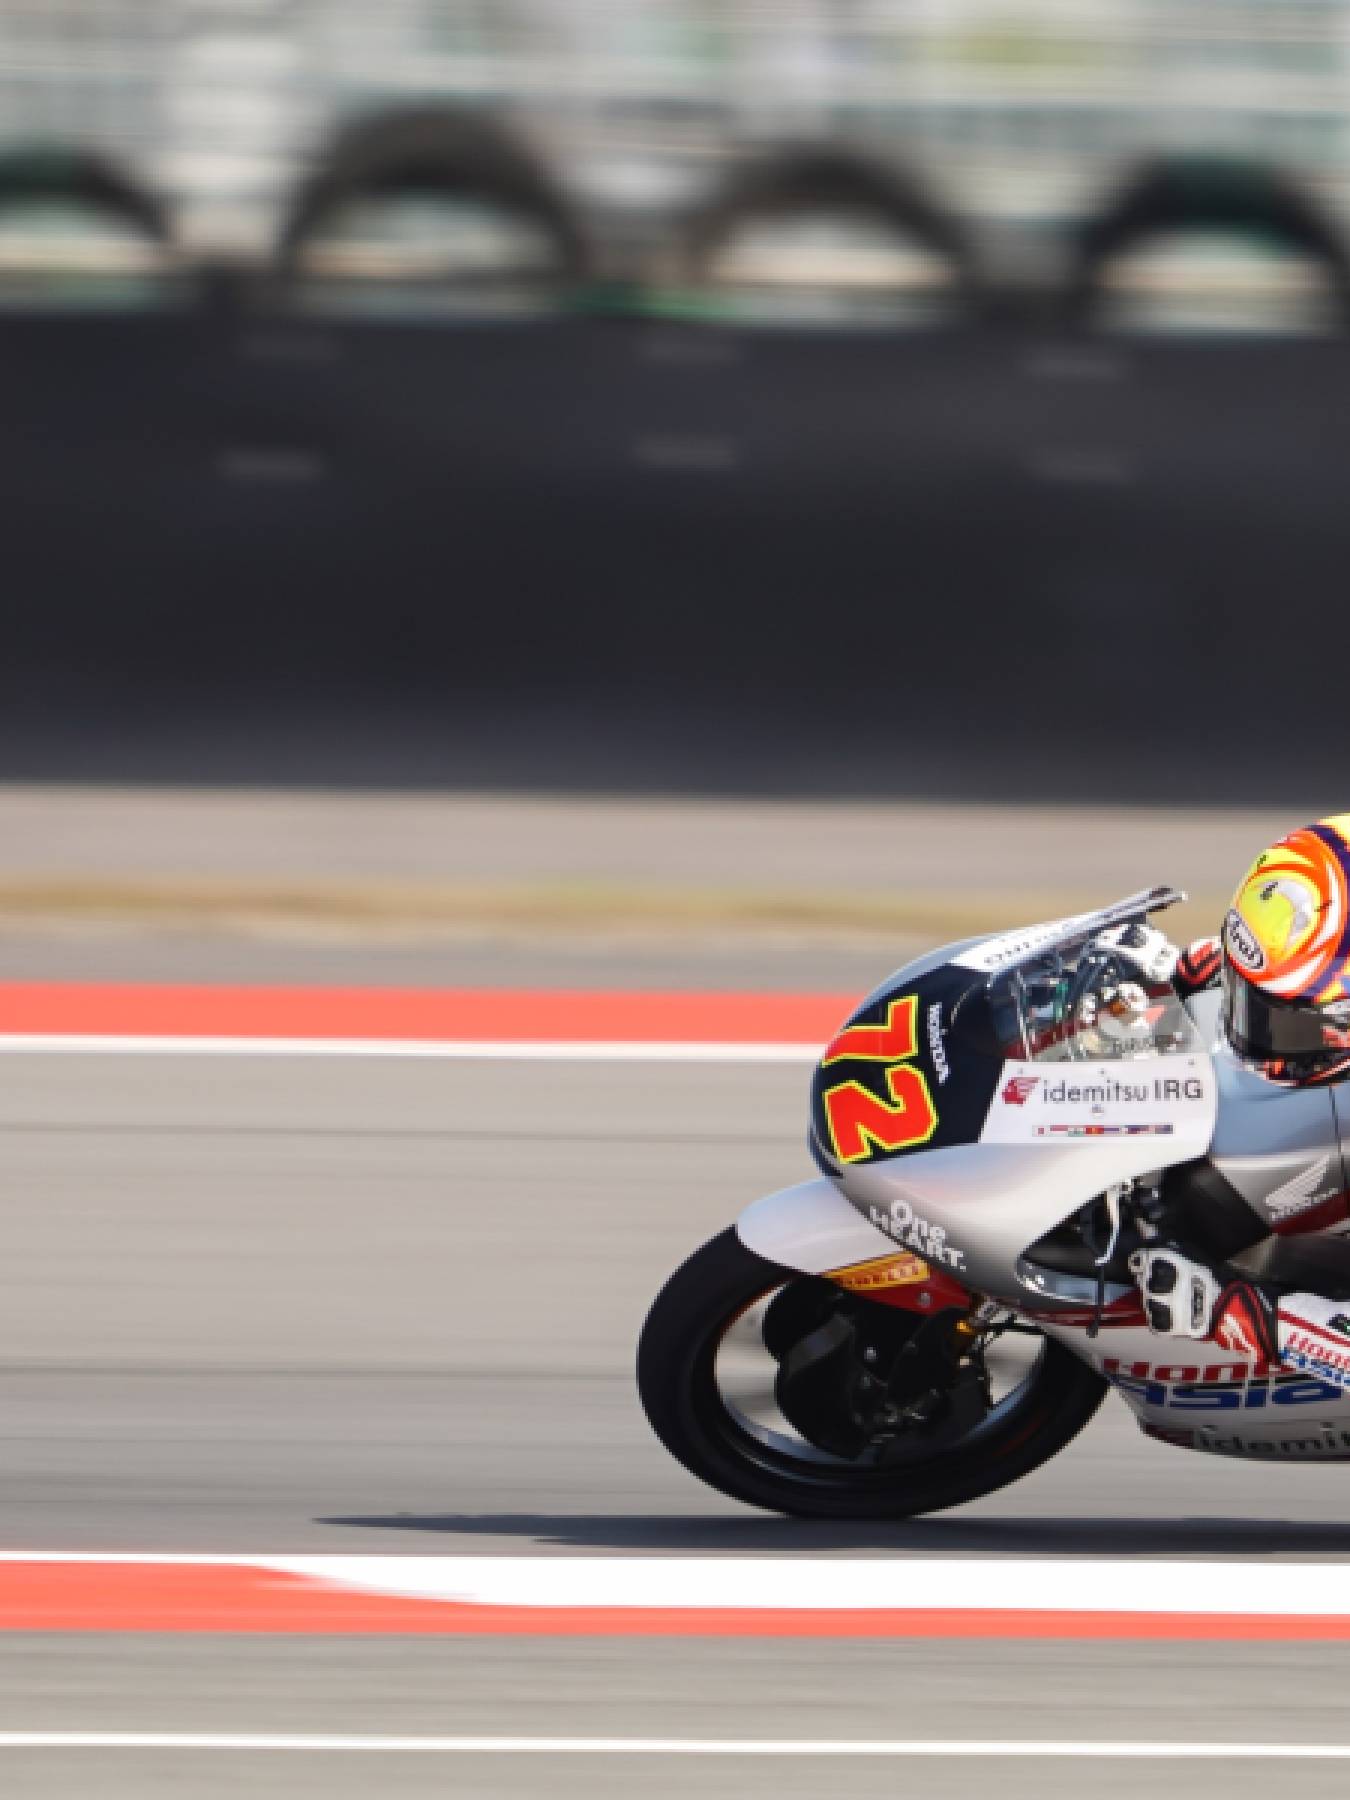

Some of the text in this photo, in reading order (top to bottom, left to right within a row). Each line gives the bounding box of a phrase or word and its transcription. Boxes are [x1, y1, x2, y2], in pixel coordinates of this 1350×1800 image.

[1042, 1077, 1204, 1102] idemitsu IRG
[888, 1201, 946, 1242] One
